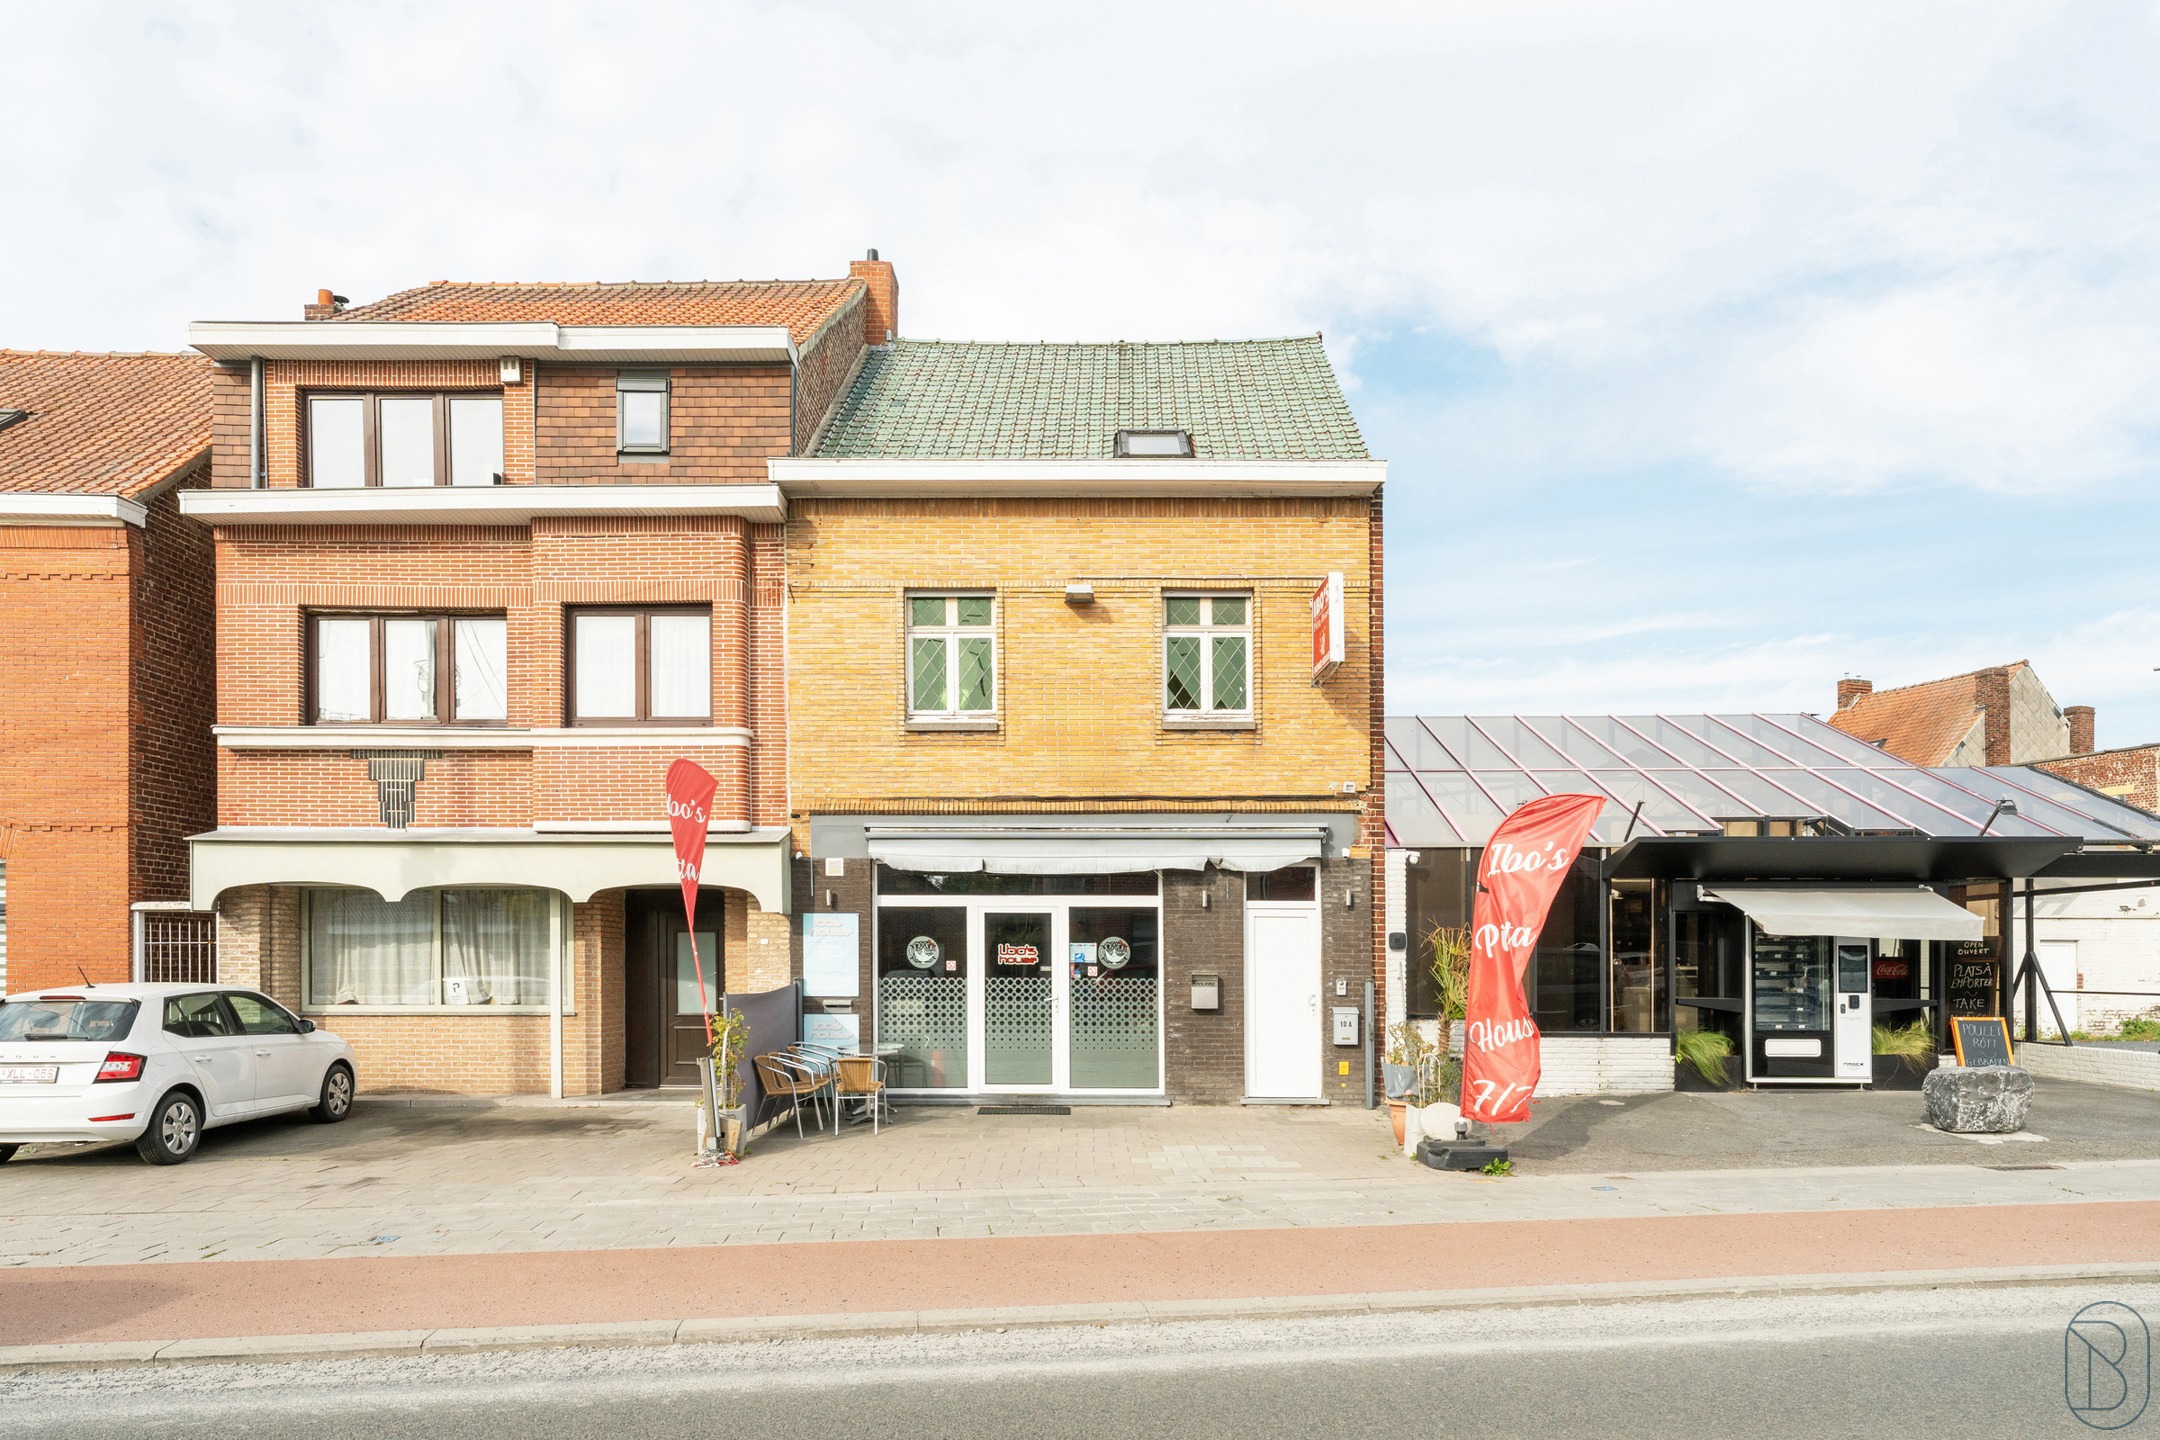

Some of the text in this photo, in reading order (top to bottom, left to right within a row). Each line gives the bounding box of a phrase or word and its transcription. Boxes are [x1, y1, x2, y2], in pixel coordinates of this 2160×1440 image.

[1487, 841, 1570, 878] Ibo's
[1964, 941, 1984, 949] OPEN
[1953, 963, 1983, 978] PLATS
[1950, 977, 1993, 989] EMPORTER
[1953, 998, 1985, 1010] TAKE
[1962, 1023, 2002, 1037] POULET
